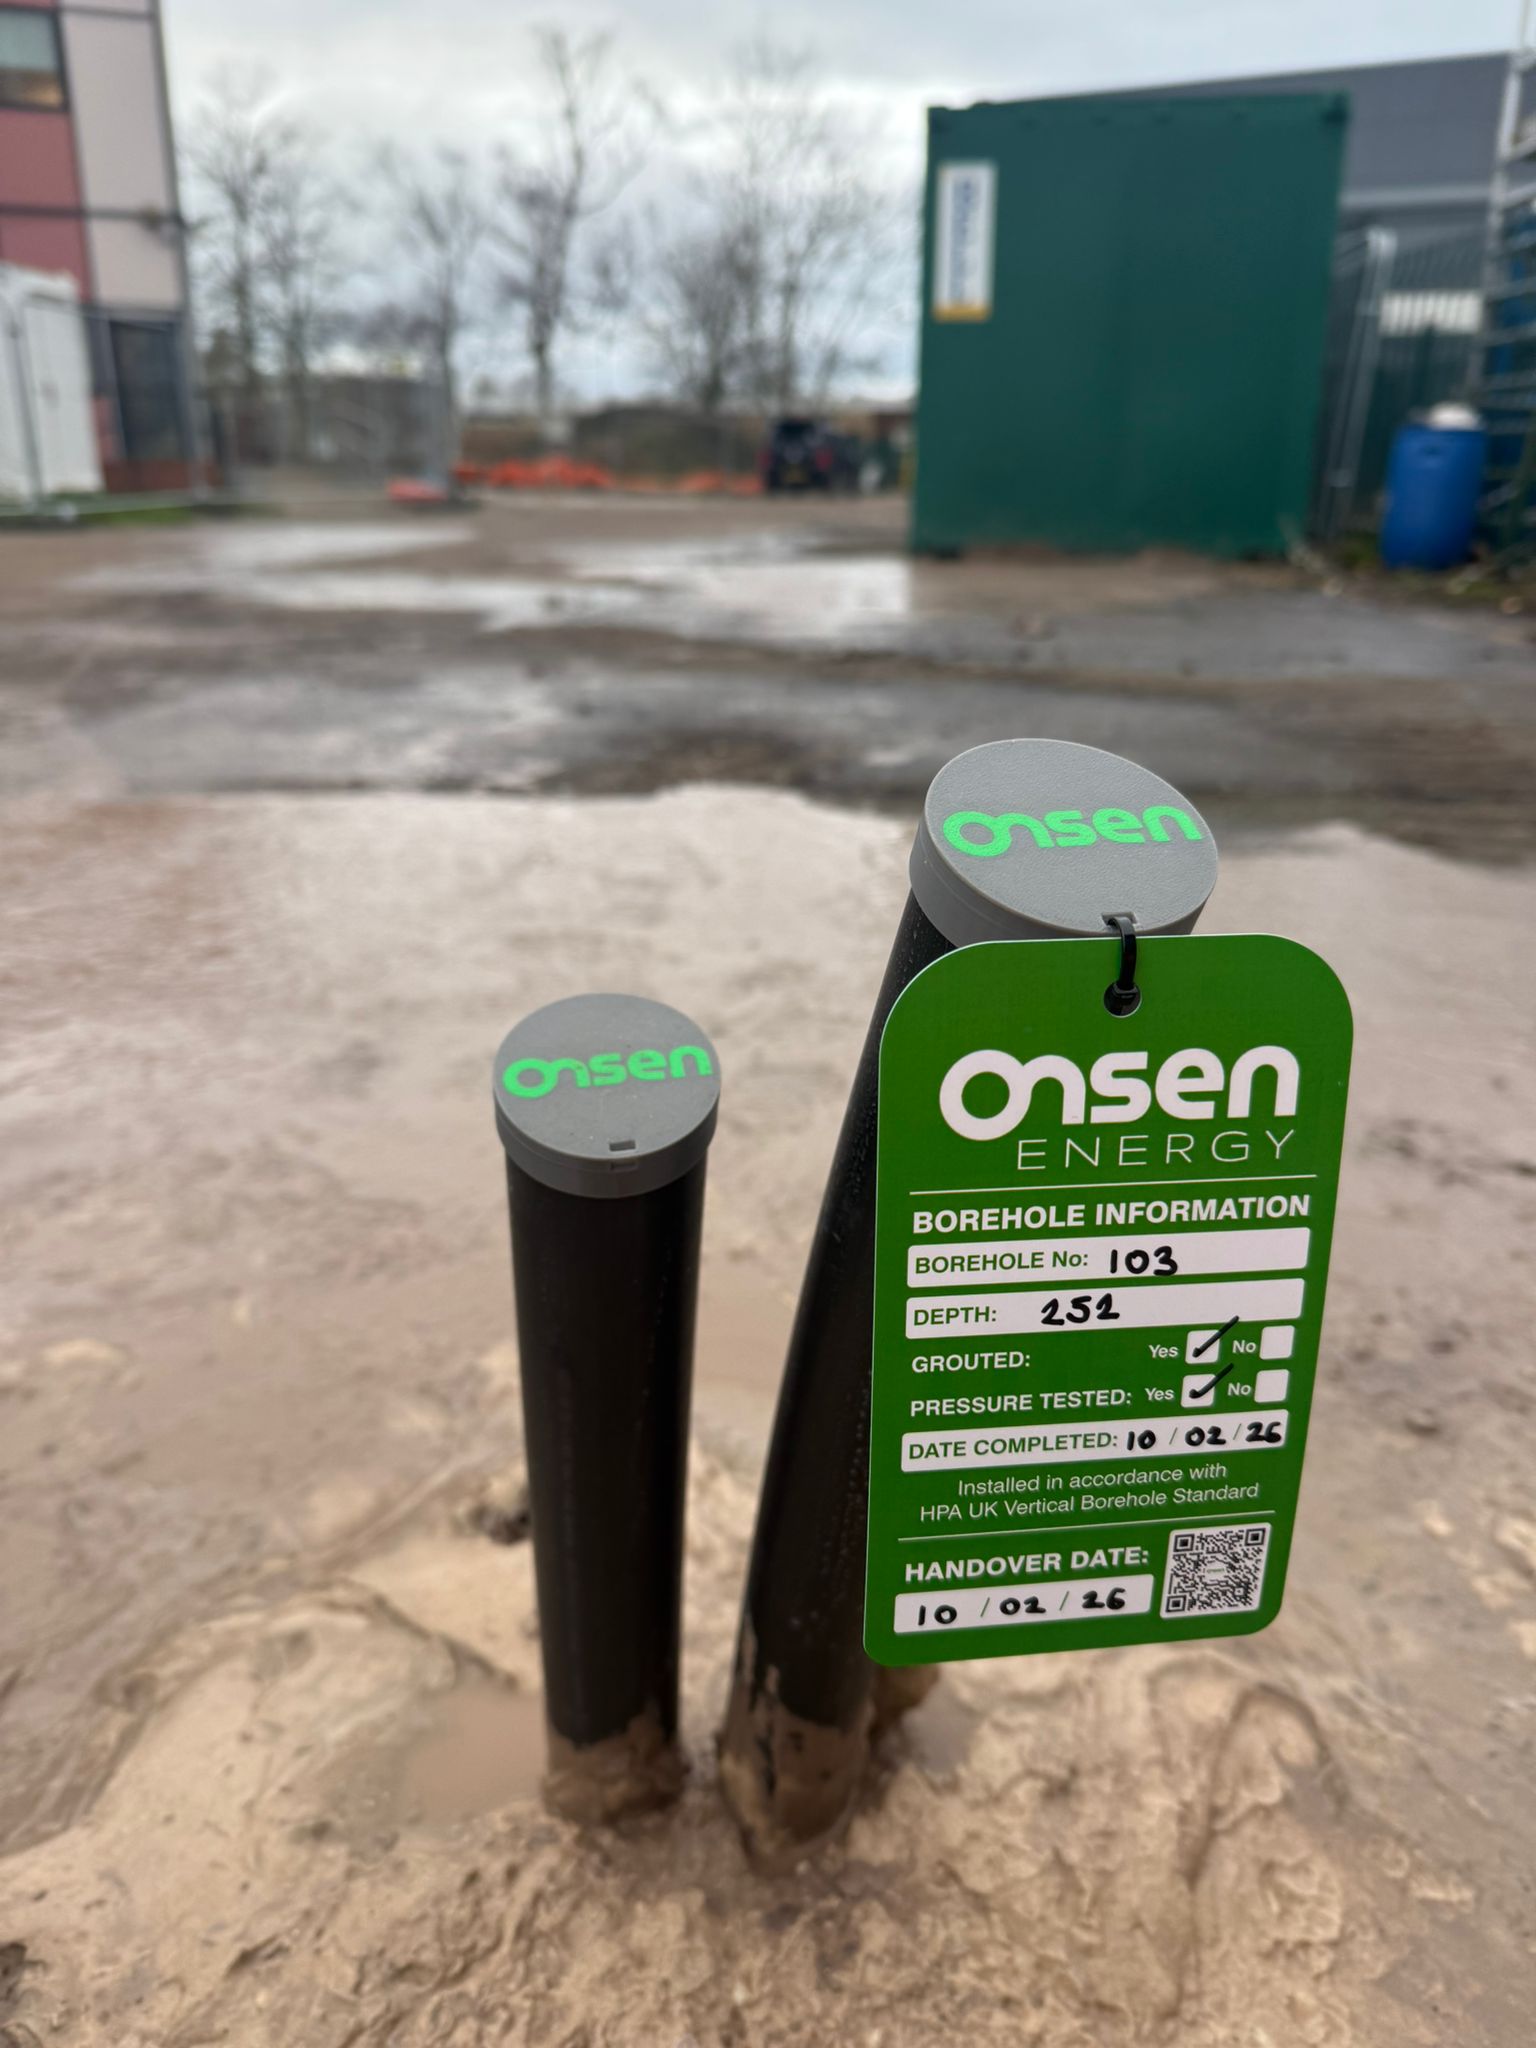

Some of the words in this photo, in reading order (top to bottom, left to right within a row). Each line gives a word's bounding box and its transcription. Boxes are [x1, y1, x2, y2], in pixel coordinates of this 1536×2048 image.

[1017, 1129, 1295, 1170] ENERGY
[912, 1204, 1085, 1234] BOREHOLE
[1096, 1194, 1310, 1226] INFORMATION
[915, 1251, 1045, 1275] BOREHOLE
[1051, 1249, 1088, 1269] No:
[1110, 1245, 1178, 1276] 103
[913, 1306, 997, 1326] DEPTH:
[911, 1352, 1031, 1373] GROUTED:
[1149, 1344, 1178, 1358] Yes
[1232, 1340, 1256, 1353] No
[910, 1394, 1032, 1417] PRESSURE
[1039, 1389, 1132, 1411] TESTED:
[1145, 1388, 1174, 1401] Yes
[1228, 1383, 1251, 1396] No
[909, 1440, 966, 1460] DATE
[973, 1432, 1118, 1456] COMPLETED:
[957, 1474, 1041, 1496] Installed
[1045, 1475, 1063, 1490] in
[1070, 1465, 1184, 1488] accordance
[1189, 1462, 1228, 1479] with
[920, 1503, 962, 1522] HPA
[969, 1501, 998, 1518] UK
[1005, 1495, 1075, 1516] Vertical
[1081, 1490, 1167, 1511] Borehole
[1173, 1482, 1260, 1504] Standard
[905, 1553, 1061, 1582] HANDOVER
[1071, 1546, 1150, 1570] DATE:
